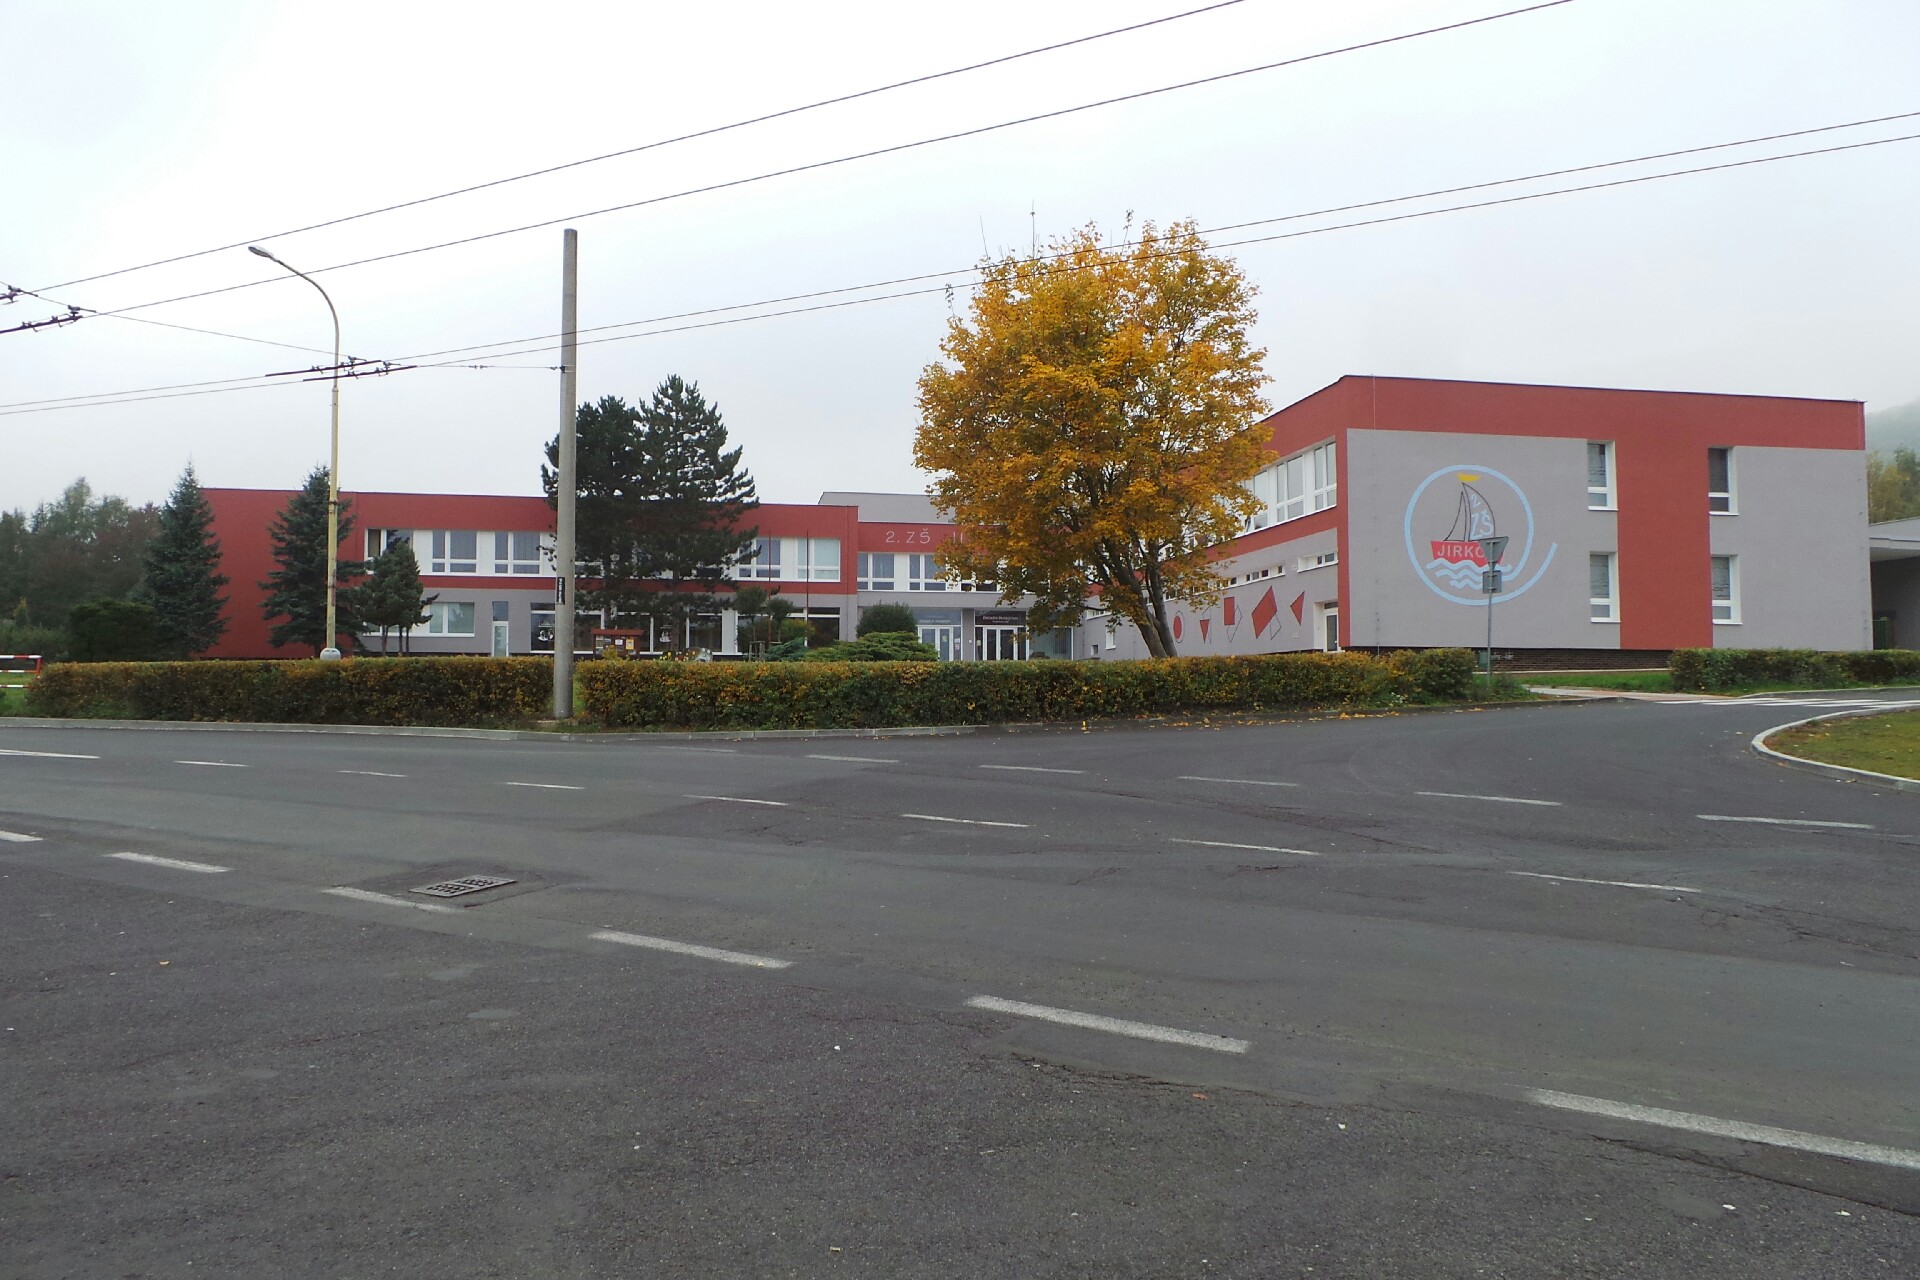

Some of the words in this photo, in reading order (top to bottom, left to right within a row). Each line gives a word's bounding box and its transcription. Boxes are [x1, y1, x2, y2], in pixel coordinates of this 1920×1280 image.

[1470, 510, 1494, 540] ZŠ
[885, 530, 900, 544] 2.
[906, 528, 931, 545] ZŠ
[1437, 544, 1485, 559] JIRKO
